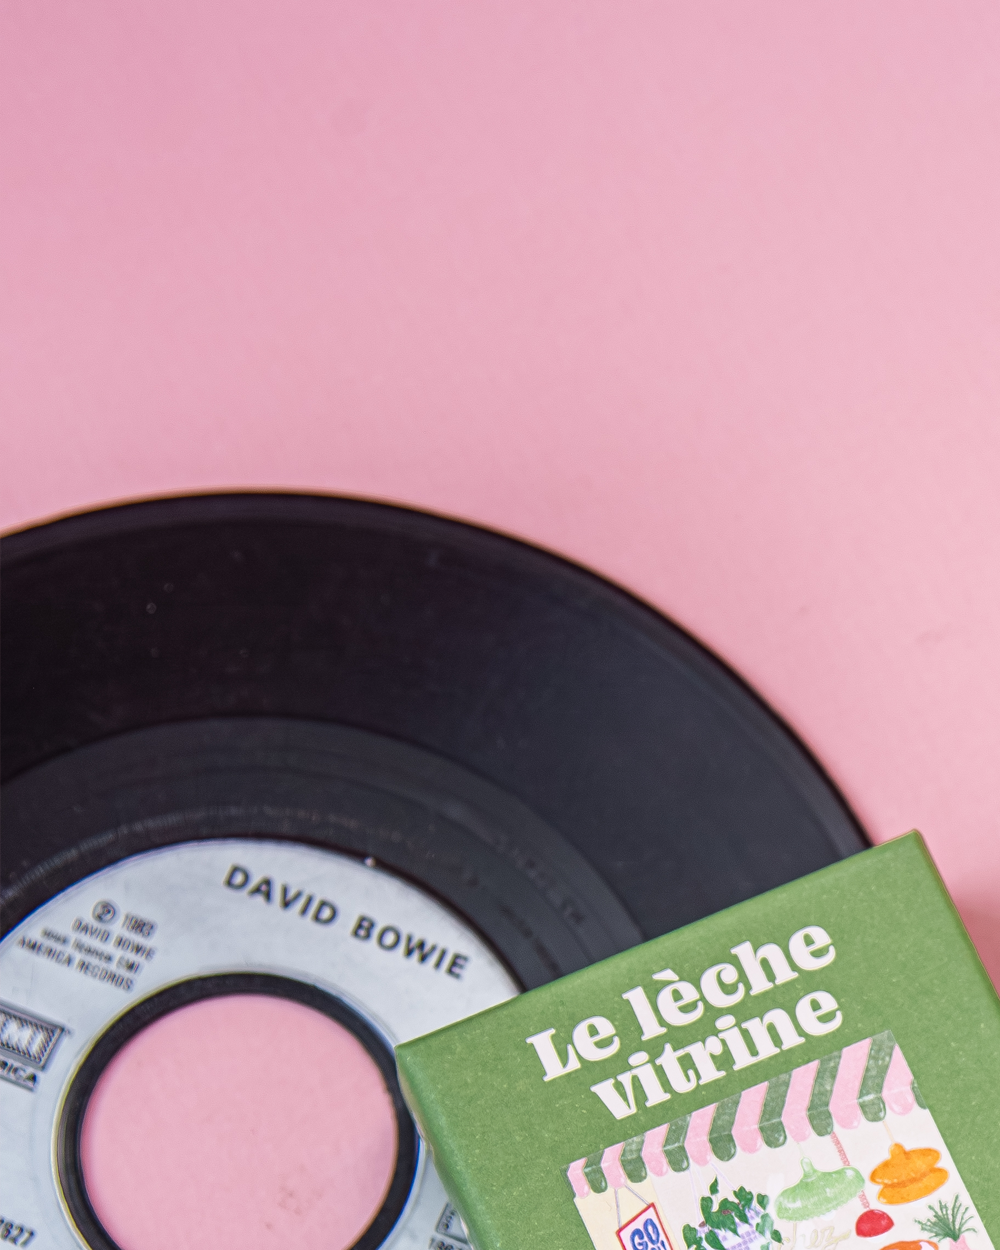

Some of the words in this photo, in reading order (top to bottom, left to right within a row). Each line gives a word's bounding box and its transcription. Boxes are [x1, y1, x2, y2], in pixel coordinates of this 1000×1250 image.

[18, 936, 72, 967] AMERICA
[76, 958, 134, 991] RECORDS
[71, 917, 110, 942] DAVID
[113, 933, 155, 960] BOWIE
[223, 864, 338, 925] DAVID
[351, 914, 469, 980] BOWIE
[526, 1015, 621, 1081] Le
[622, 925, 836, 1041] lèche
[590, 990, 843, 1119] vitrine
